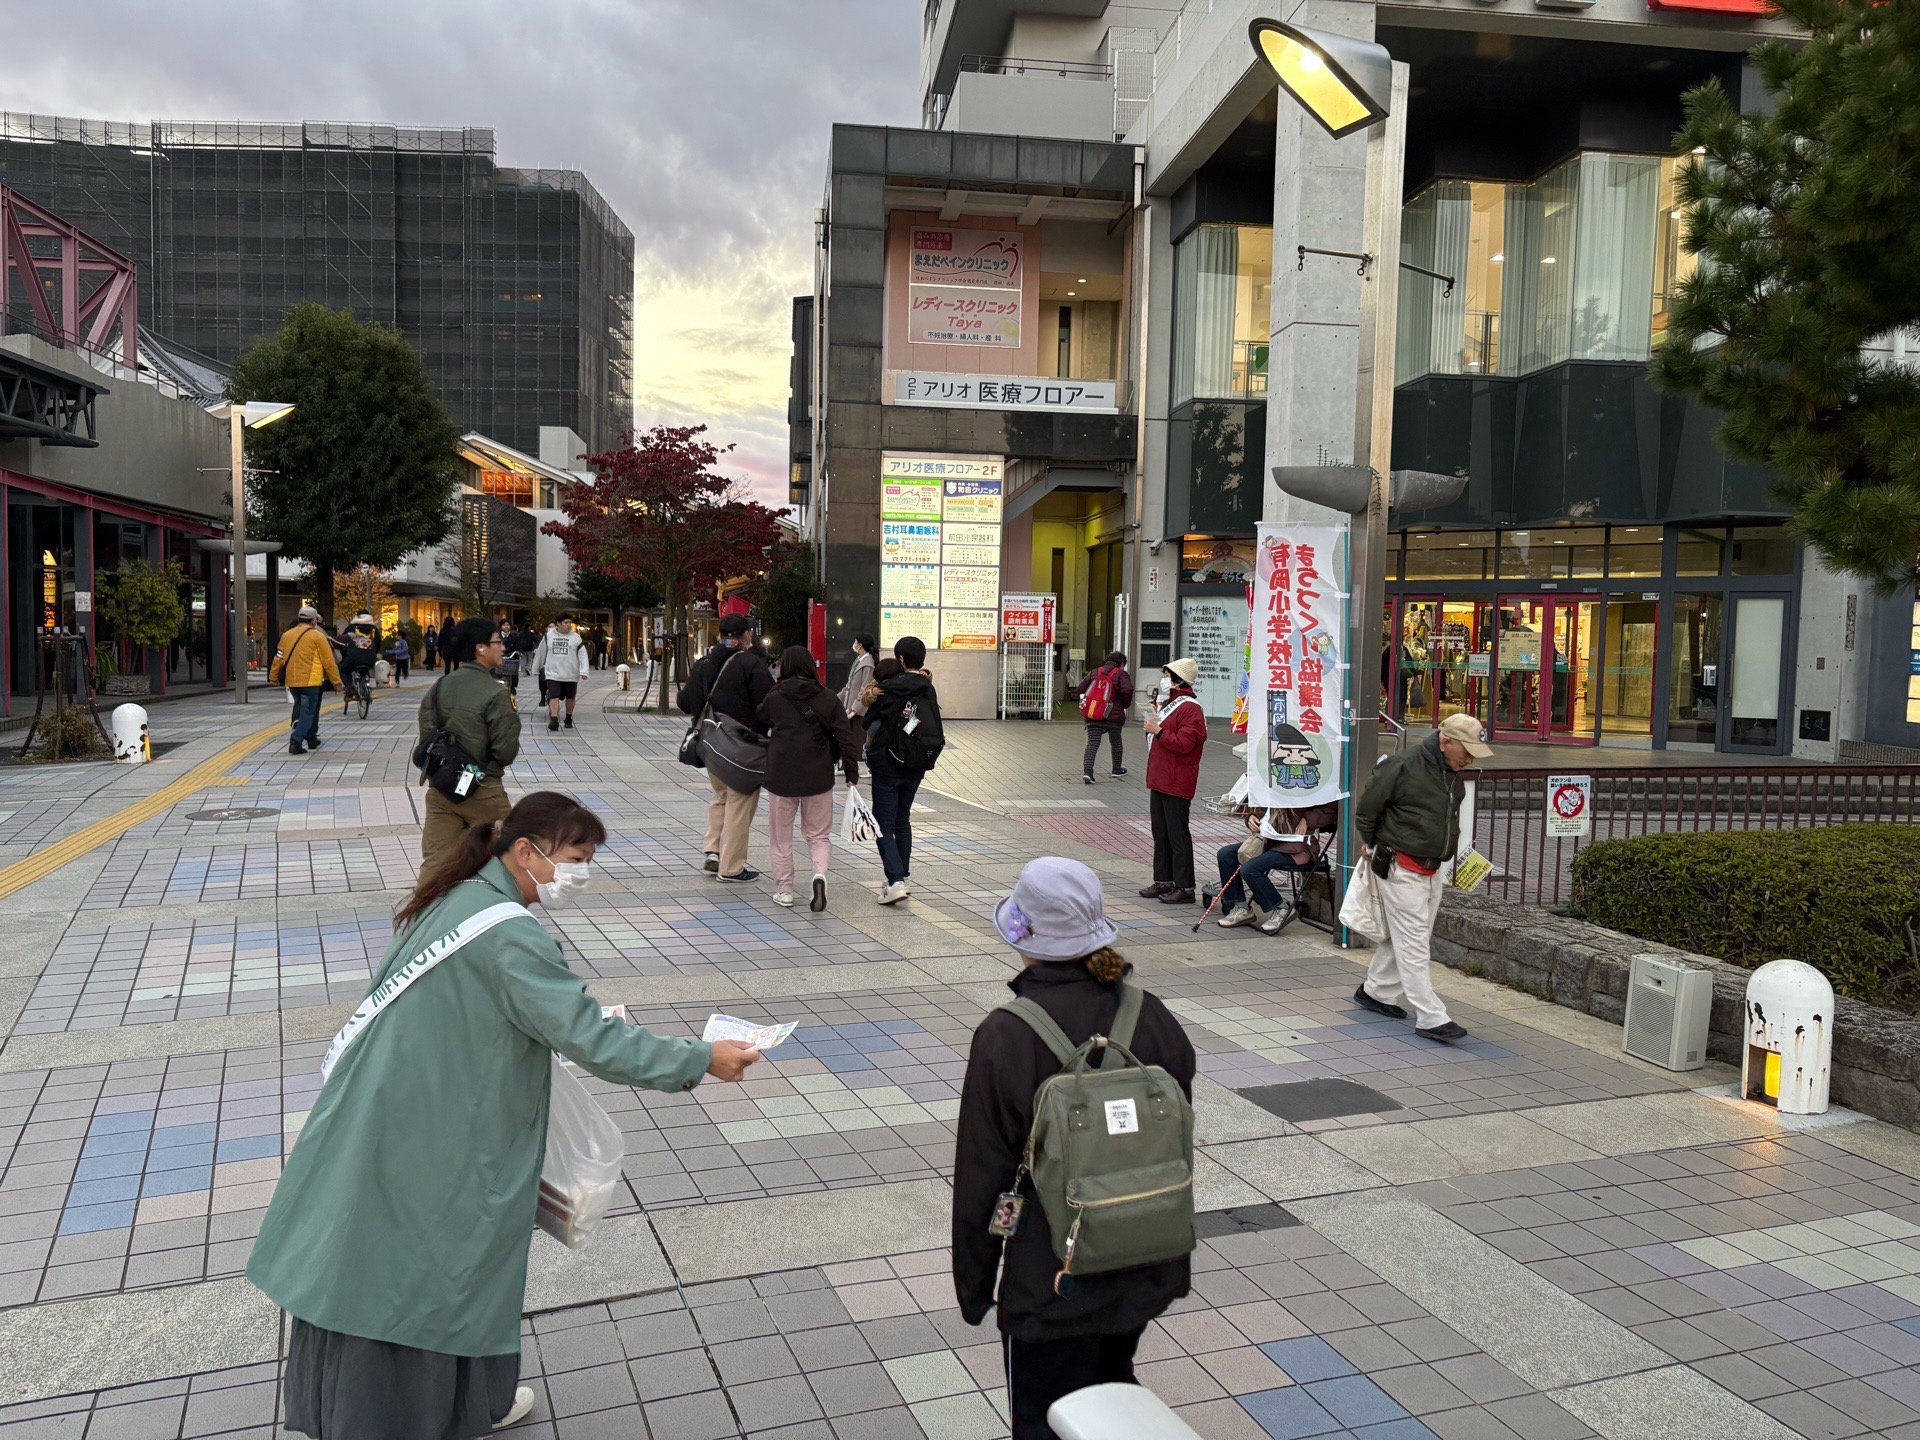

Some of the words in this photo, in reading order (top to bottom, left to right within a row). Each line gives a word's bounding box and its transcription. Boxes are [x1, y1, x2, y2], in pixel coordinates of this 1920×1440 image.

[914, 253, 1009, 271] まえだペインクリニック
[912, 295, 1018, 315] レディースクリニック
[948, 316, 983, 330] Taya
[908, 377, 917, 399] 2F
[890, 461, 980, 475] アリオ医療フロアー
[982, 465, 998, 476] 2F
[958, 487, 999, 495] 和田クリニック
[883, 524, 939, 535] 吉村耳鼻咽喉科
[943, 568, 998, 577] レディースクリニック
